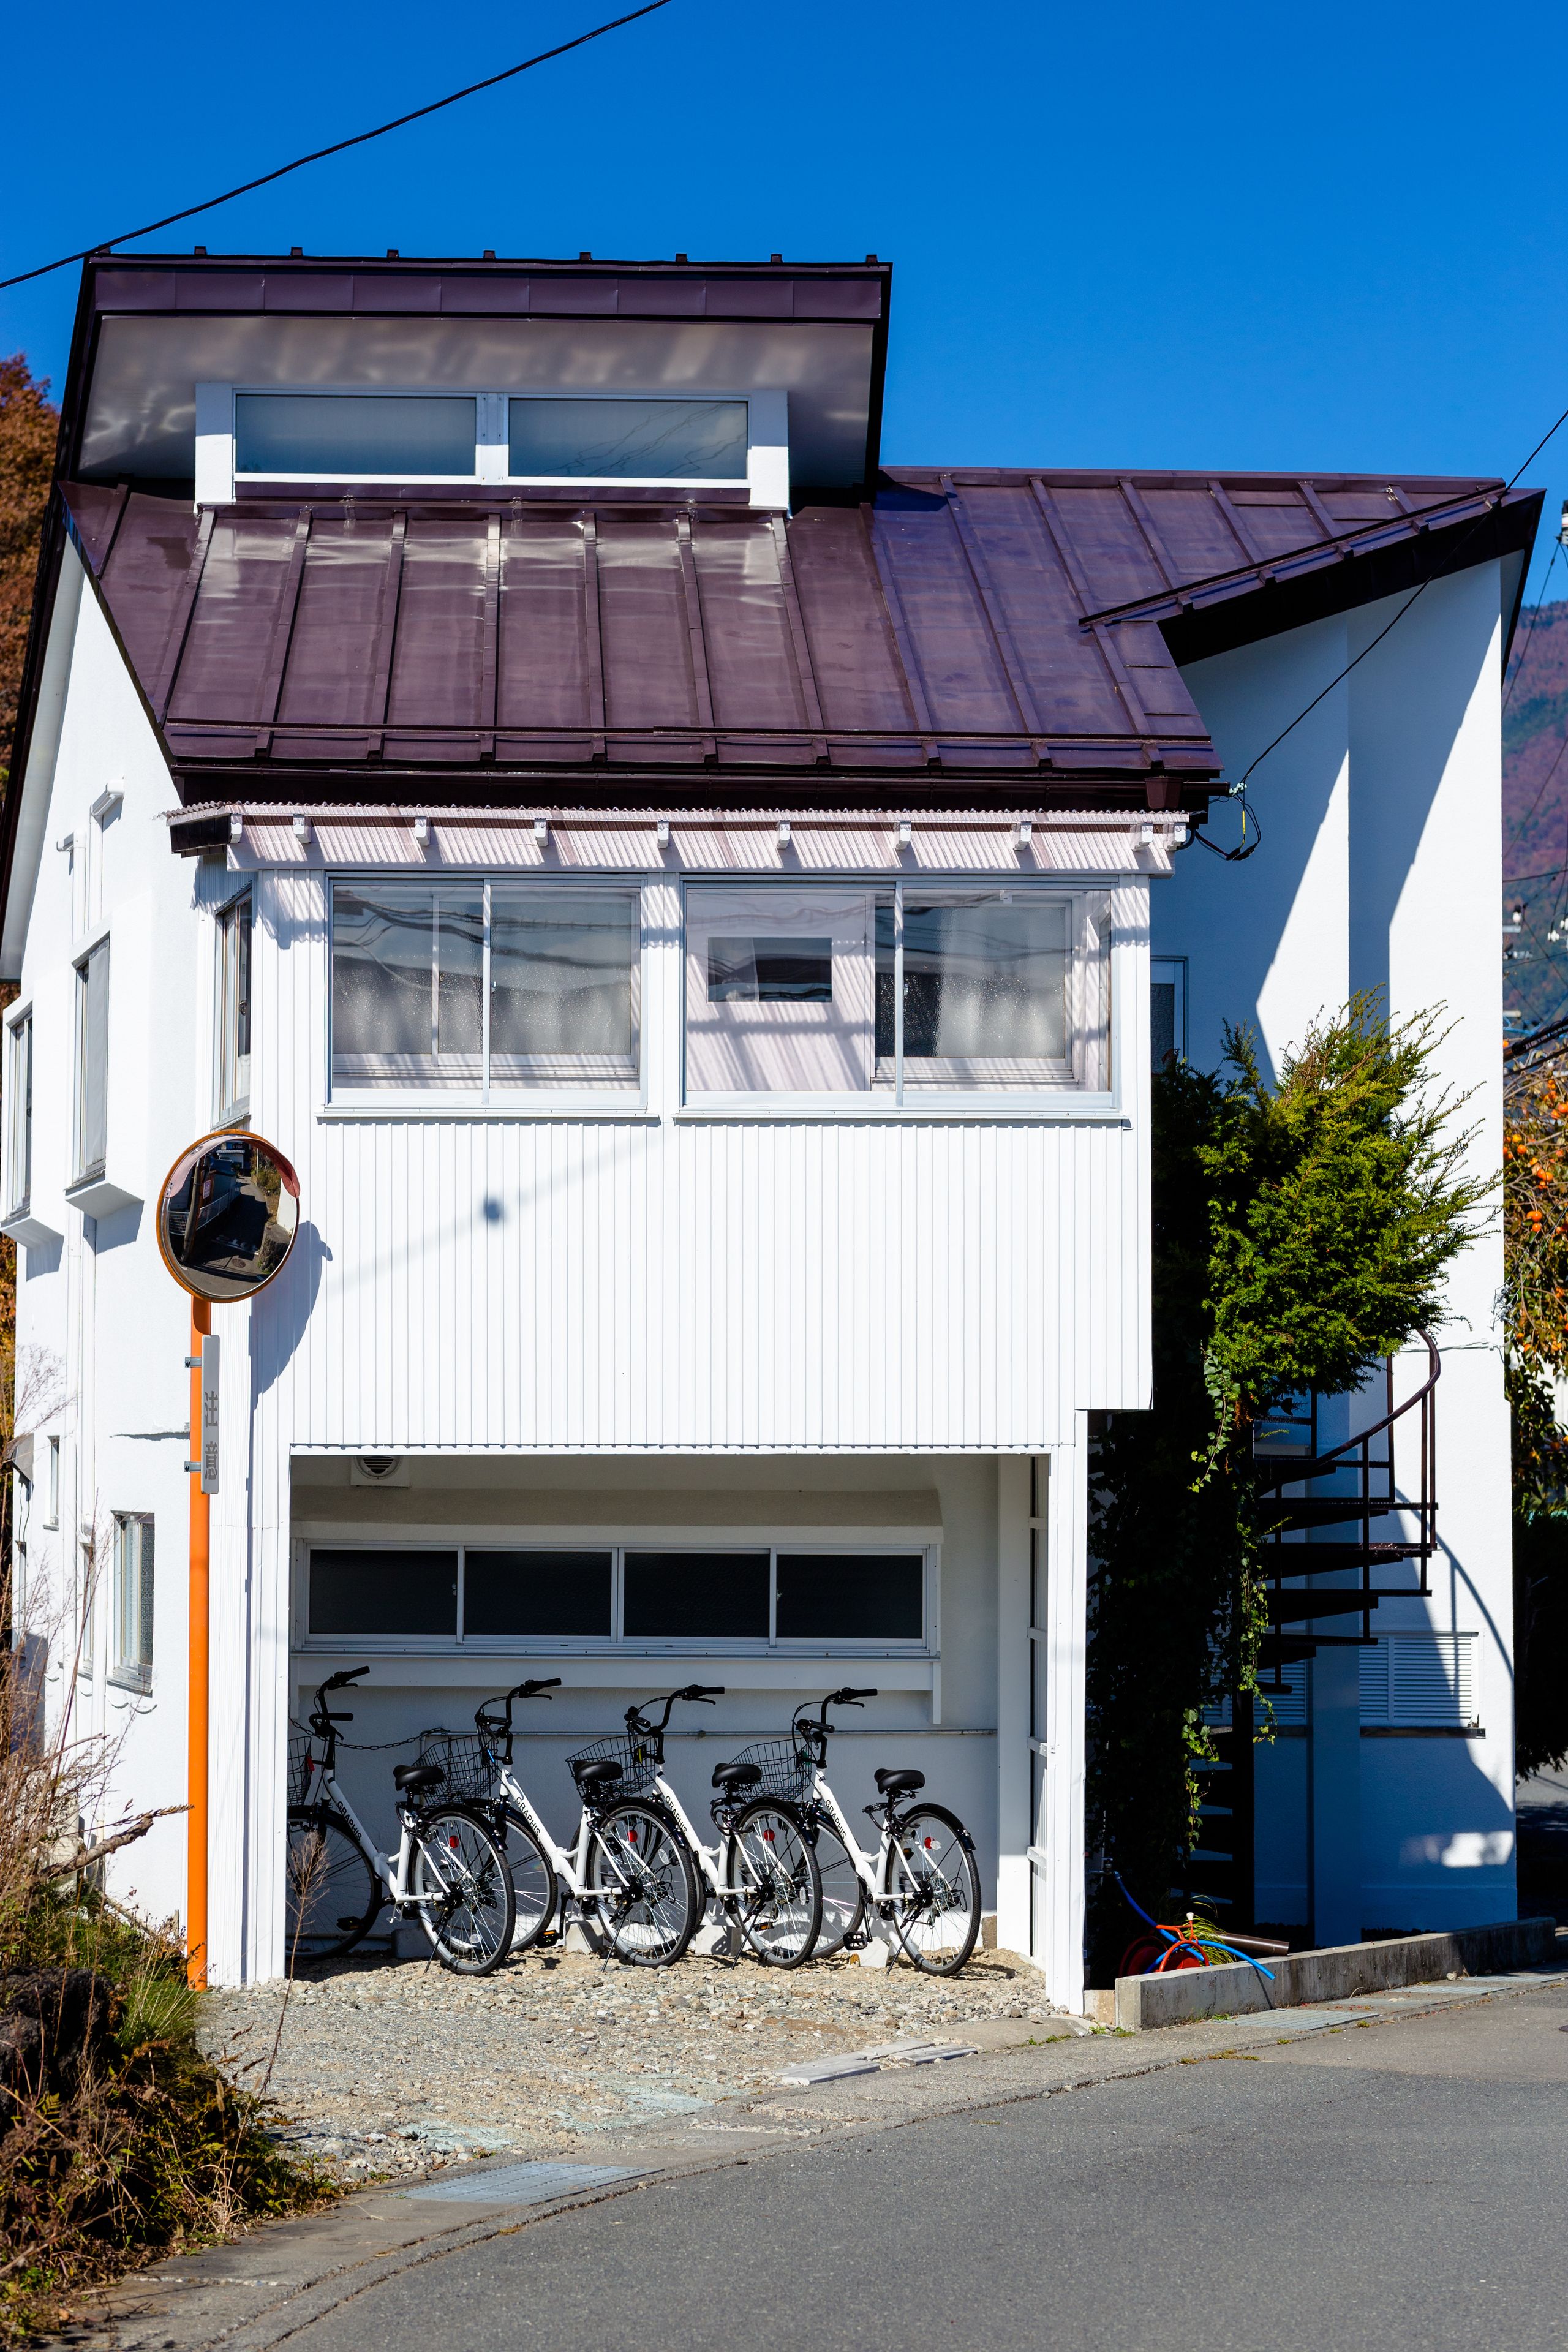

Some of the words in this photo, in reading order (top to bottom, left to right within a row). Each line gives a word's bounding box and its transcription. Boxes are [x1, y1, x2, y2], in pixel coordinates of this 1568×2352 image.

[205, 1390, 219, 1480] 注意
[337, 1801, 362, 1841] GRAPHIS
[516, 1796, 540, 1836] GRAPHIS
[666, 1795, 687, 1834] GRAPHIS
[826, 1800, 846, 1839] GRAPHIS
